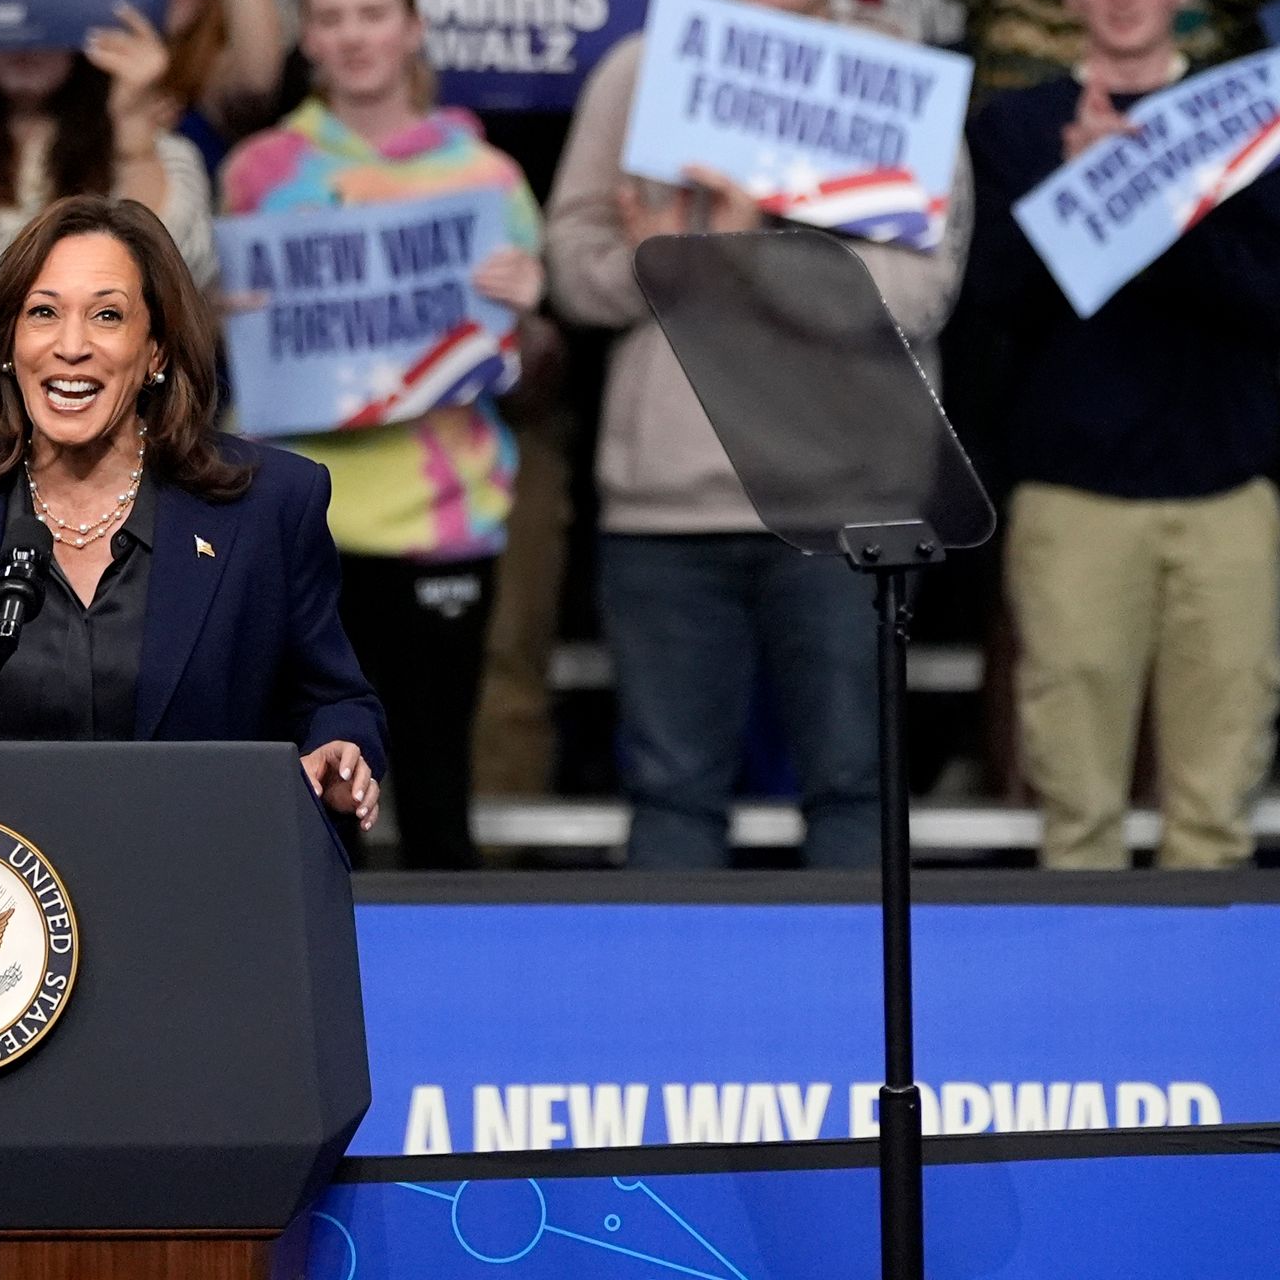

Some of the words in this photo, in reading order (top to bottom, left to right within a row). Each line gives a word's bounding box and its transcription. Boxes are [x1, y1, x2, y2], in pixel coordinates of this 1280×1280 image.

[677, 14, 709, 62] A
[722, 22, 823, 89] NEW
[836, 49, 937, 122] WAY
[684, 70, 911, 170] FORWARD
[247, 239, 275, 291] A
[283, 230, 367, 289] NEW
[378, 215, 477, 277] WAY
[268, 279, 467, 363] FORWARD
[7, 842, 72, 955] UNITED
[403, 1083, 453, 1155] A
[472, 1083, 649, 1153] NEW
[662, 1082, 832, 1144] WAY
